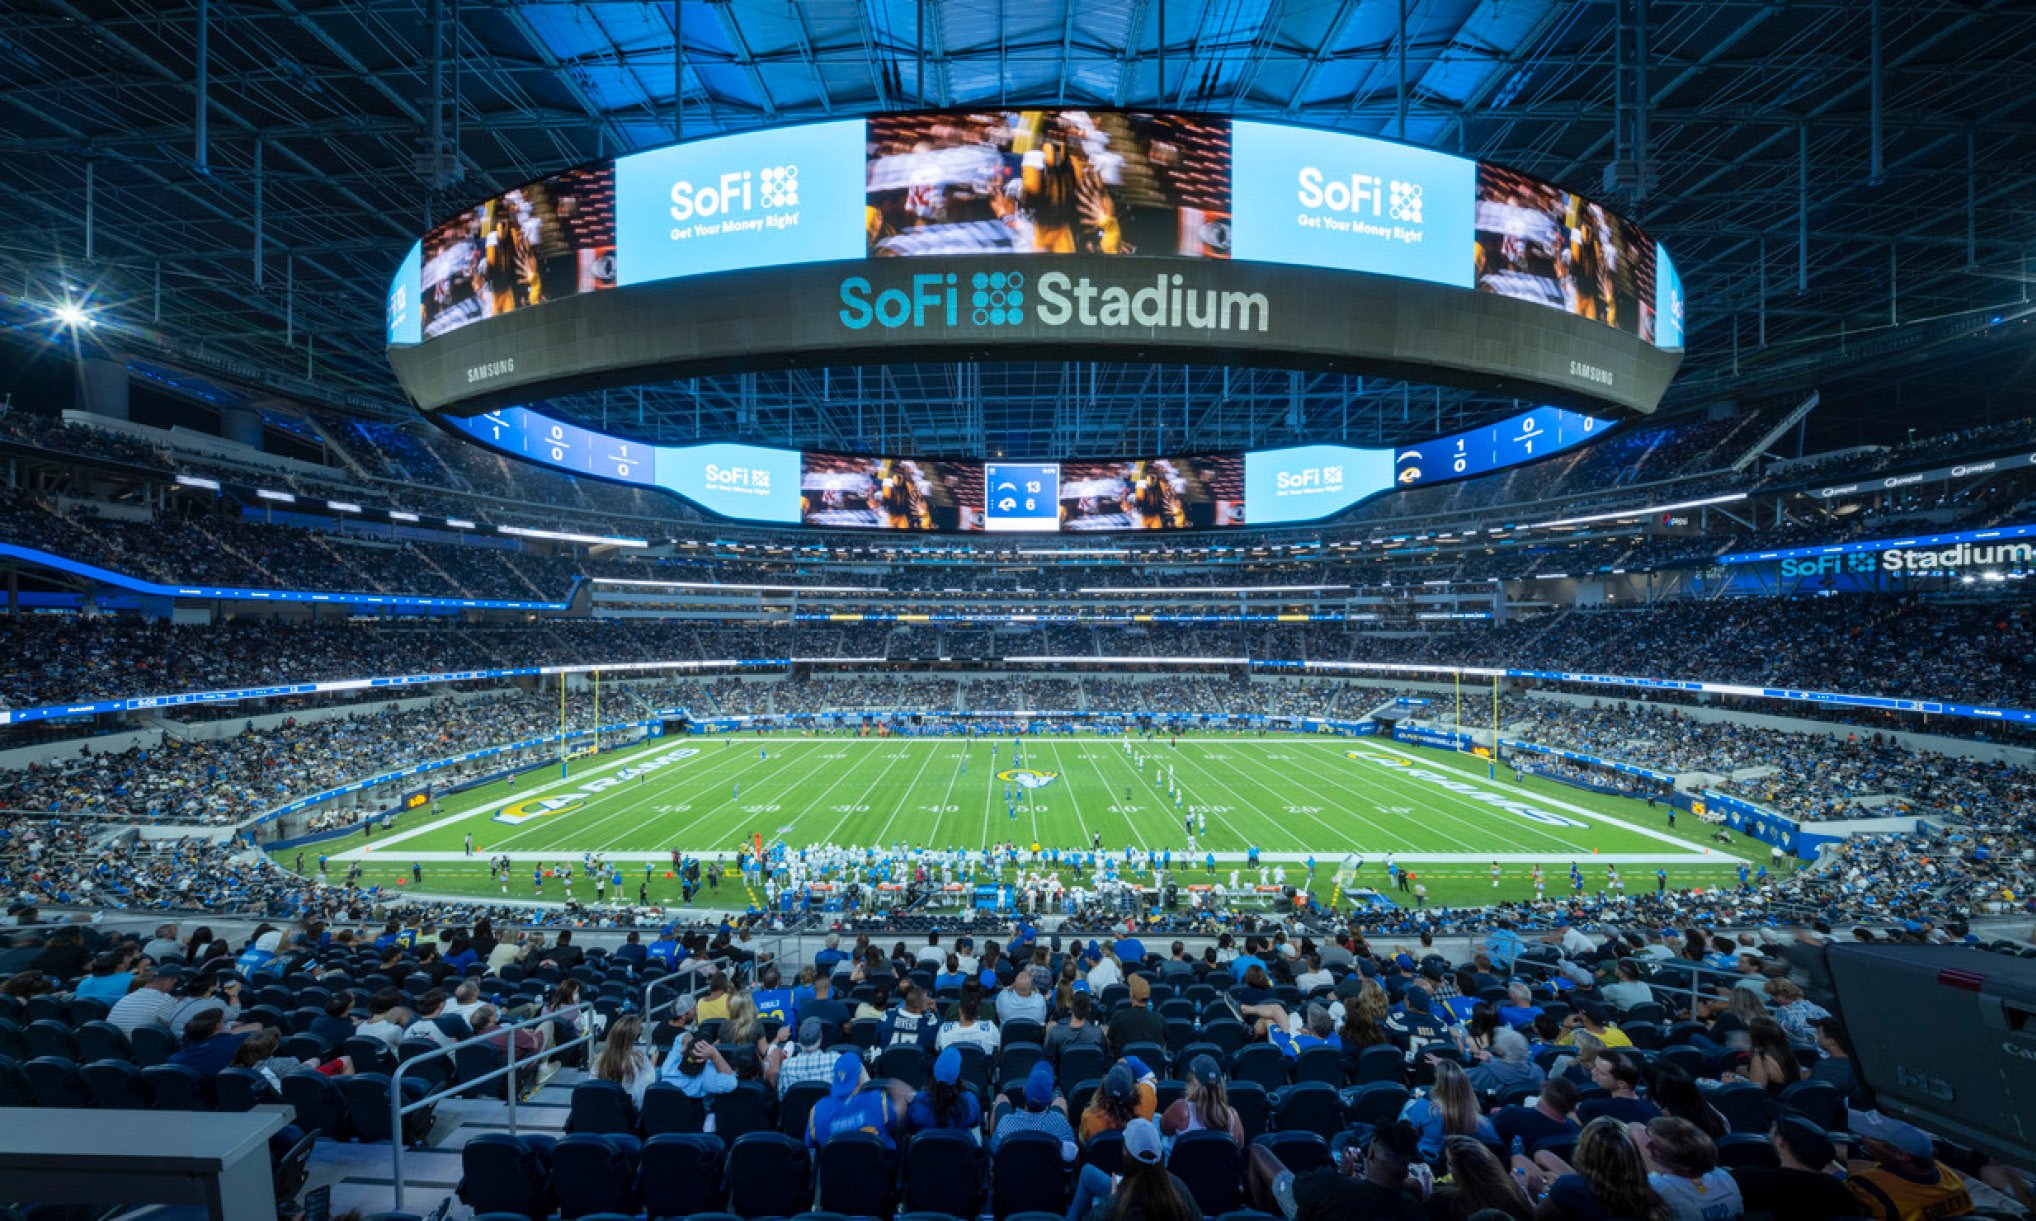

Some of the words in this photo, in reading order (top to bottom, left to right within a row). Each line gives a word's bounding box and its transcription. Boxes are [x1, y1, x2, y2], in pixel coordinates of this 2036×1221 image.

[670, 171, 752, 221] SoFi
[1298, 167, 1382, 216] SoFi
[671, 228, 692, 240] Get
[693, 224, 720, 236] Your
[722, 218, 763, 232] Money
[765, 212, 800, 229] Right
[1298, 214, 1321, 228] Get
[1323, 216, 1350, 231] Your
[1352, 220, 1391, 240] Money
[1394, 227, 1424, 243] Right
[839, 273, 958, 329] SoFi
[1036, 271, 1270, 331] Stadium
[467, 358, 514, 383] SAMSUNG
[1570, 360, 1613, 385] SAMSUNG
[1523, 417, 1536, 432] 0
[492, 426, 500, 440] 1
[551, 425, 563, 440] 0
[618, 445, 628, 457] 1
[1456, 439, 1465, 451] 1
[1524, 440, 1532, 454] 1
[552, 447, 563, 461] 0
[618, 464, 630, 476] 0
[1454, 459, 1466, 472] 0
[705, 464, 749, 485] SoFi
[1276, 467, 1319, 488] SoFi
[1026, 481, 1041, 493] 13
[1025, 498, 1036, 510] 6
[1781, 554, 1841, 577] SoFi
[1882, 543, 2032, 570] Stadium
